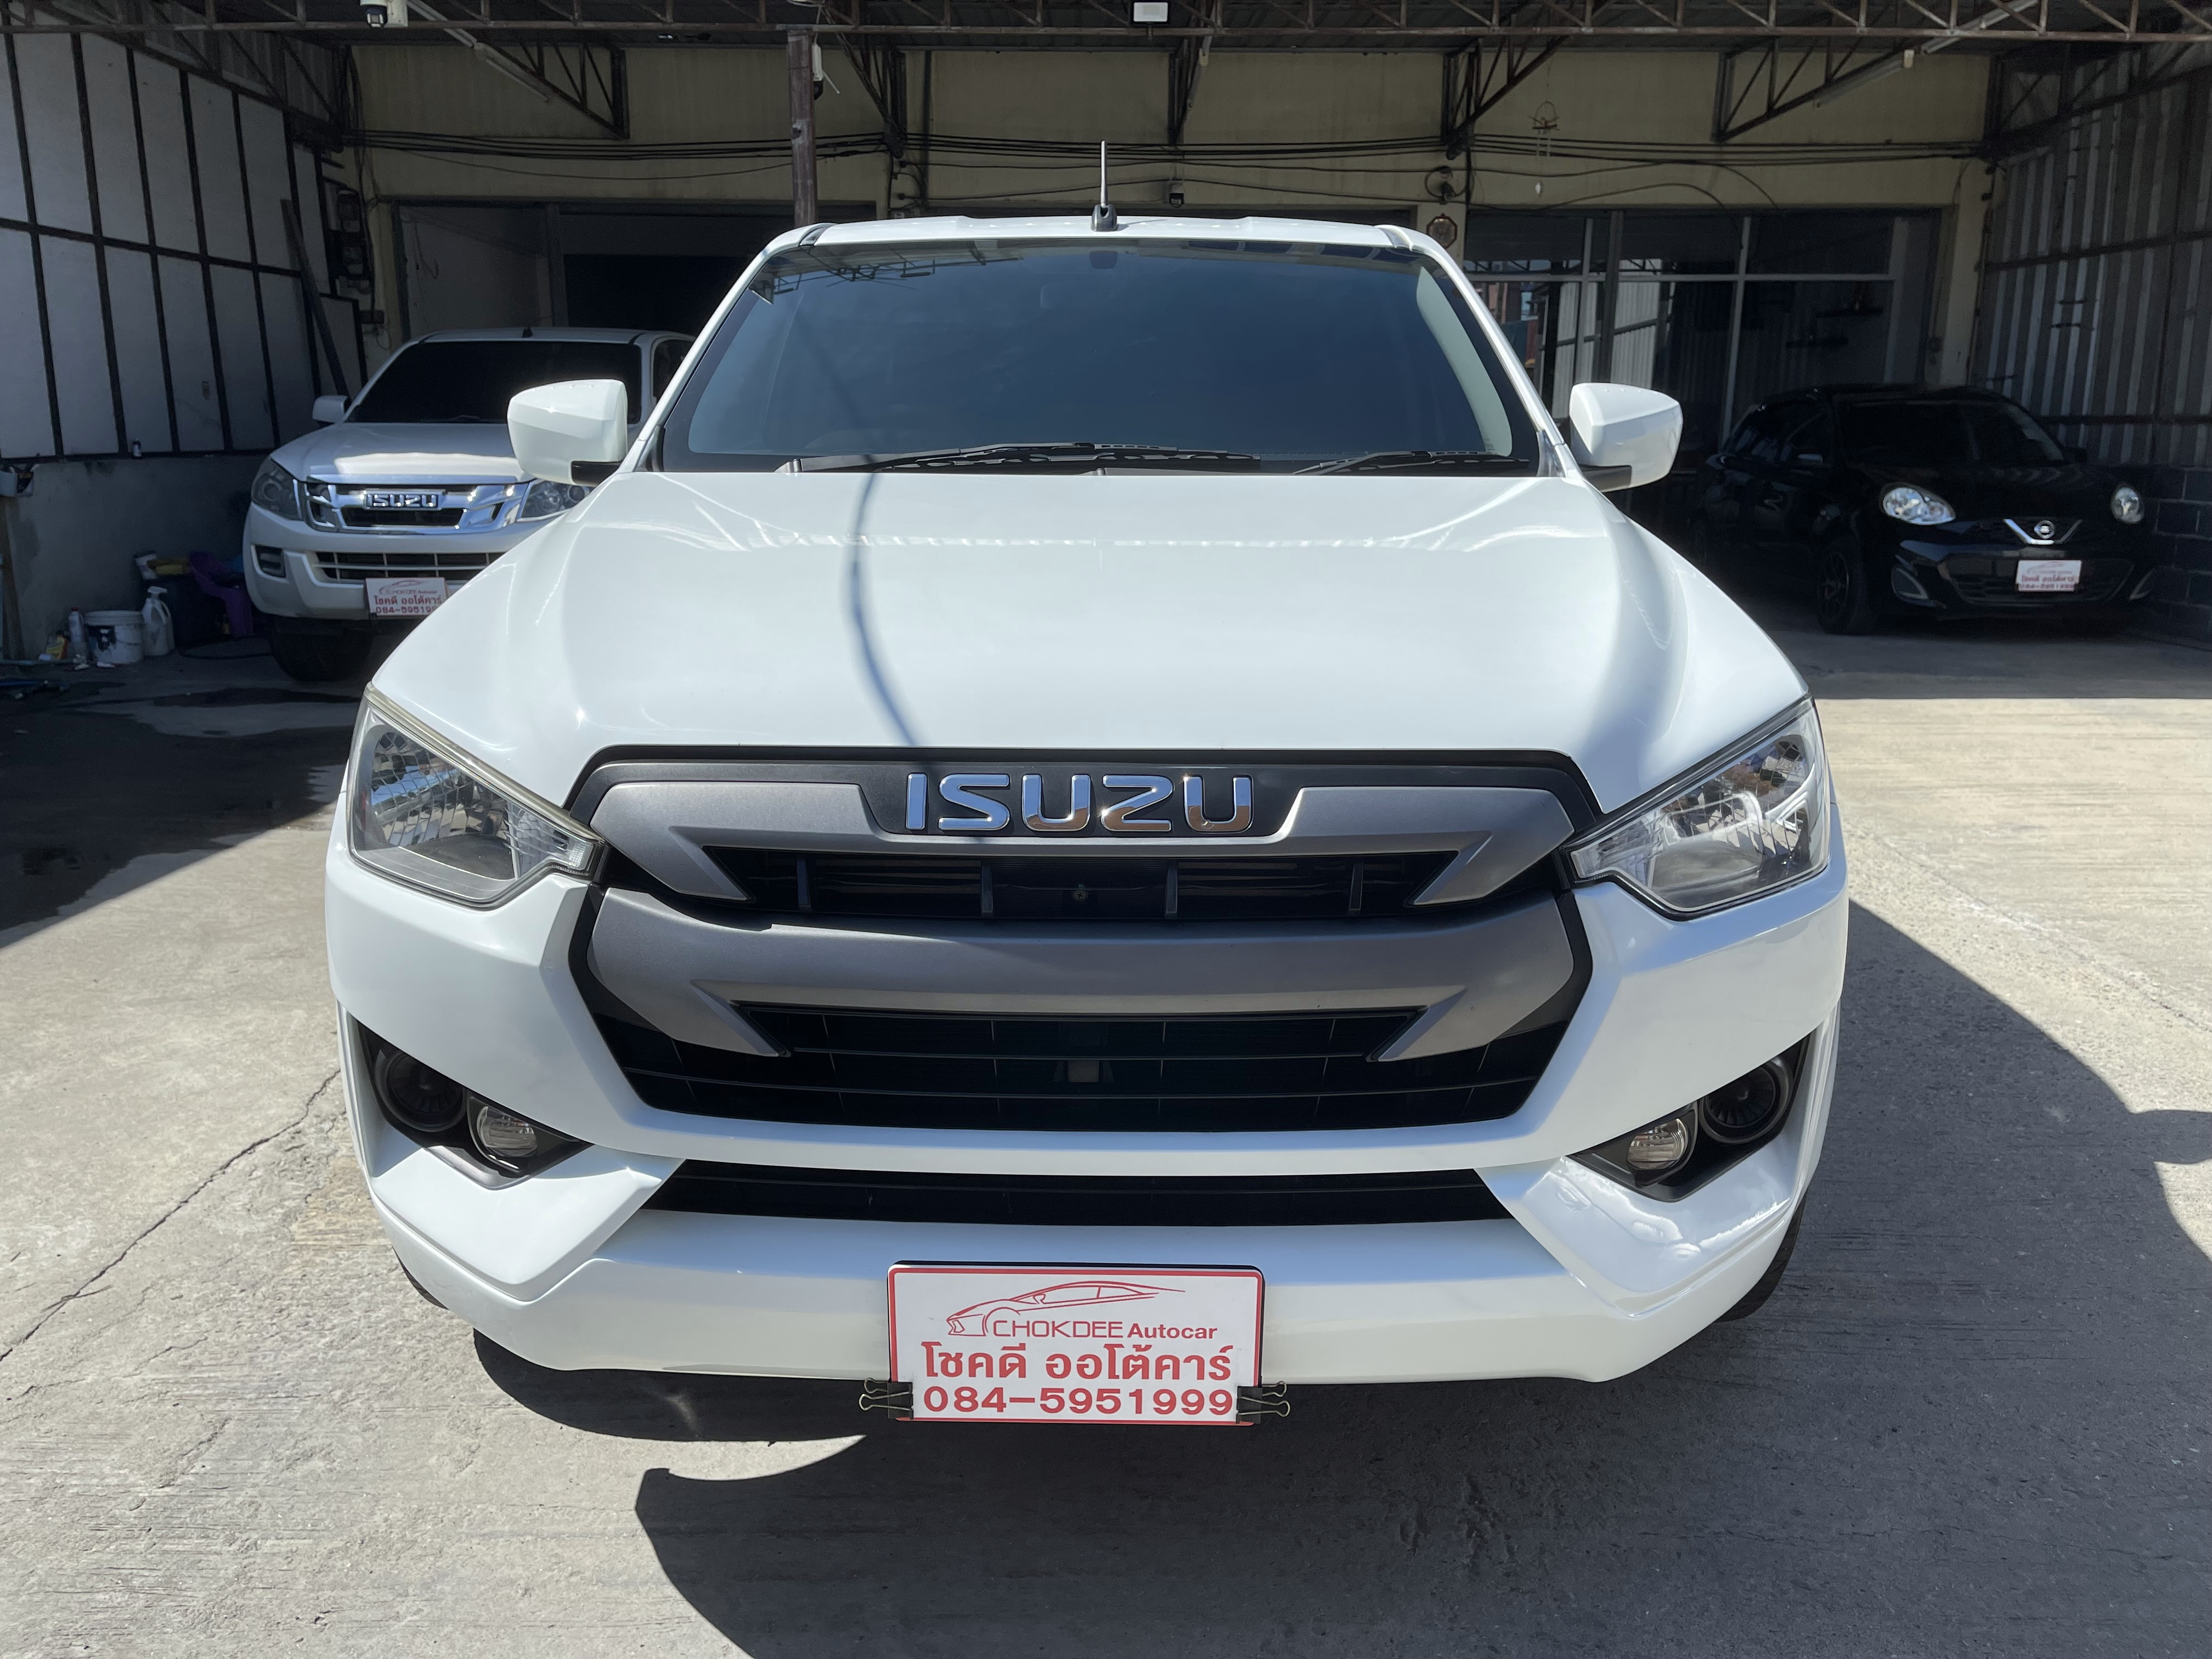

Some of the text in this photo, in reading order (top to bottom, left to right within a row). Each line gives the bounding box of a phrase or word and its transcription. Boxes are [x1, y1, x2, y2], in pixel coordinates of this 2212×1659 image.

[367, 494, 437, 507] ISUZU
[906, 773, 1255, 832] ISUZU
[993, 1320, 1218, 1339] CHOKDEE Autocar
[921, 1341, 1234, 1381] โชคดี ออโต้คาร์
[923, 1386, 1233, 1415] 084-5951999
